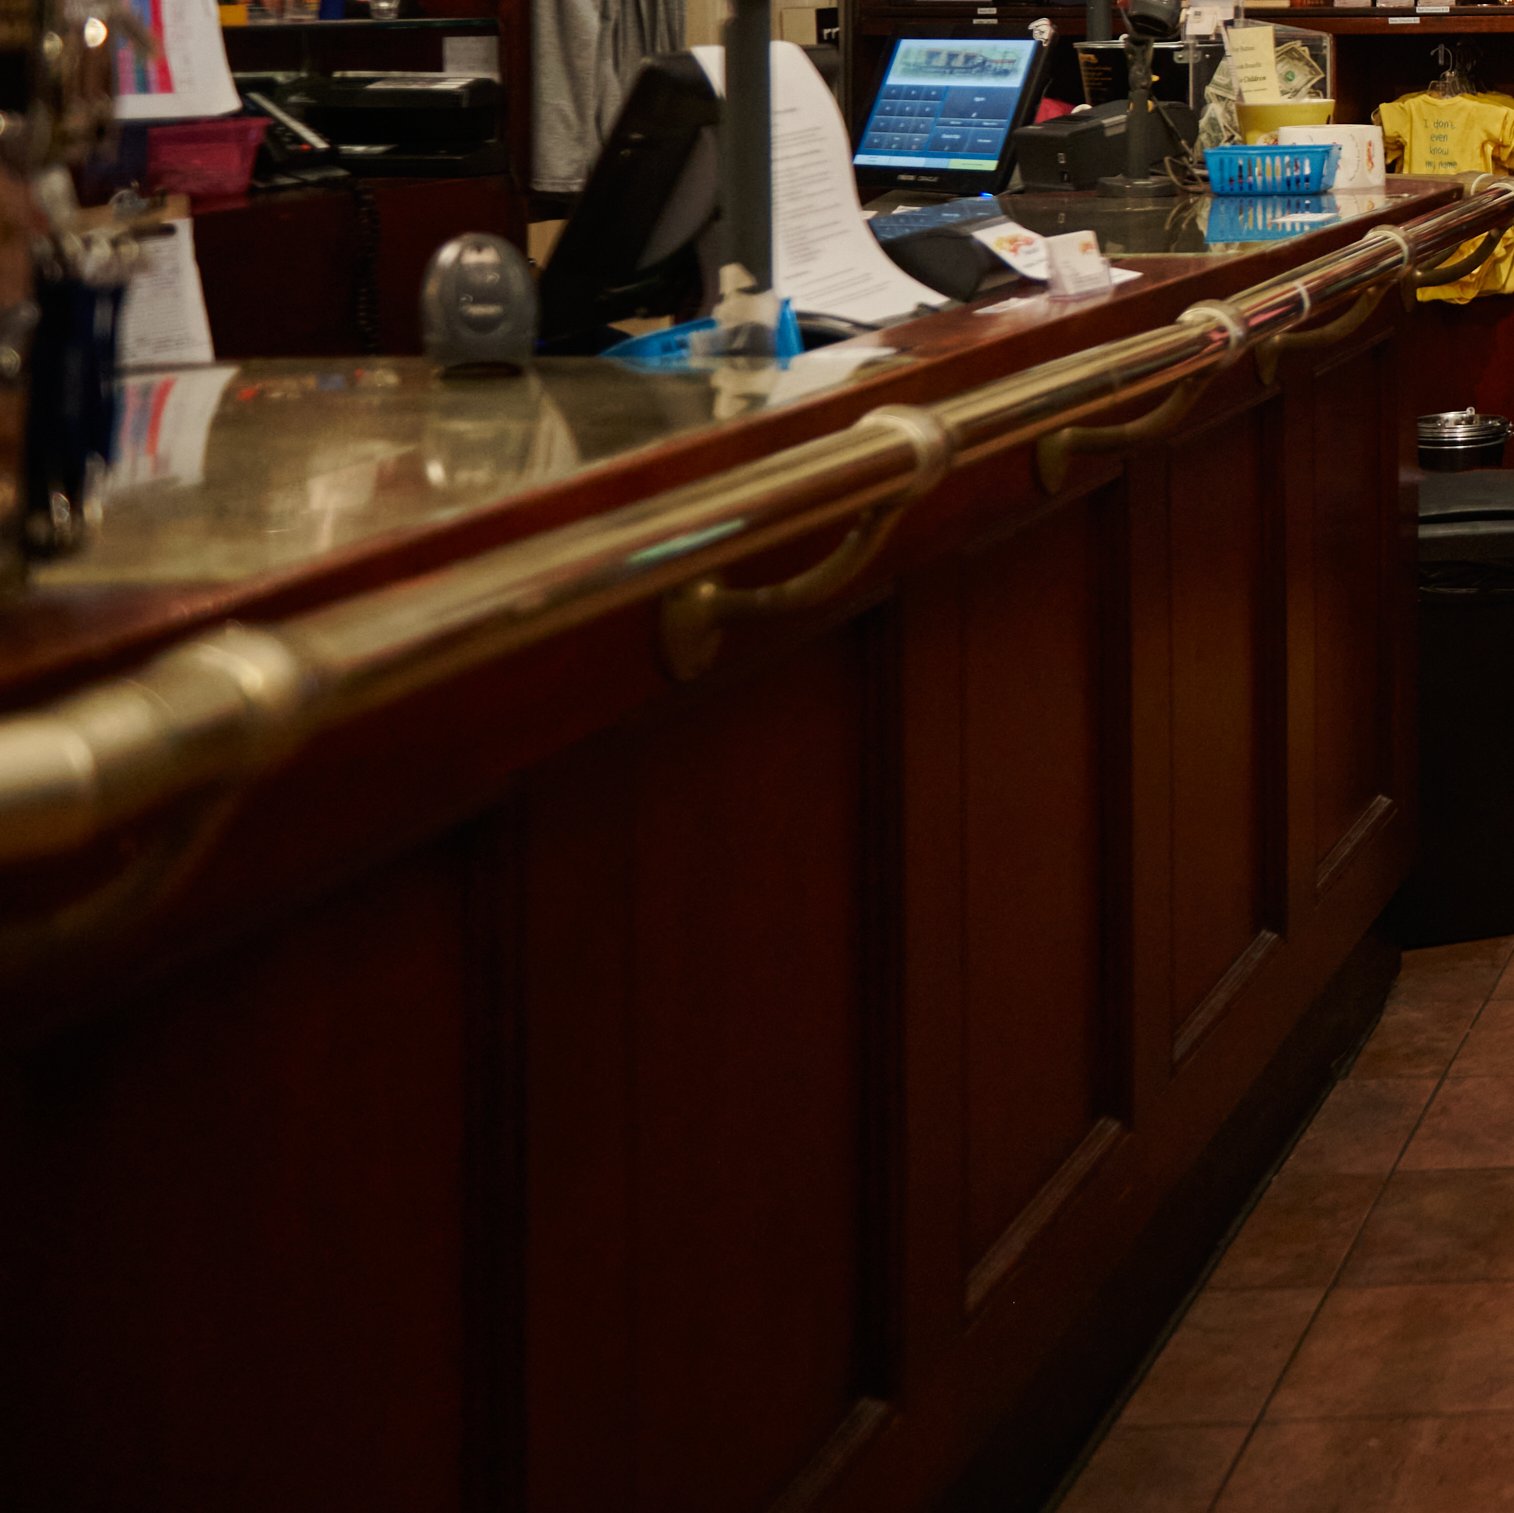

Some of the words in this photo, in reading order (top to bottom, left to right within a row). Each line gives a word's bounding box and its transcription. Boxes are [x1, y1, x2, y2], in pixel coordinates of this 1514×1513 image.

[1433, 119, 1456, 129] don't
[1430, 133, 1449, 142] even
[1430, 145, 1450, 155] know
[1438, 161, 1458, 169] name
